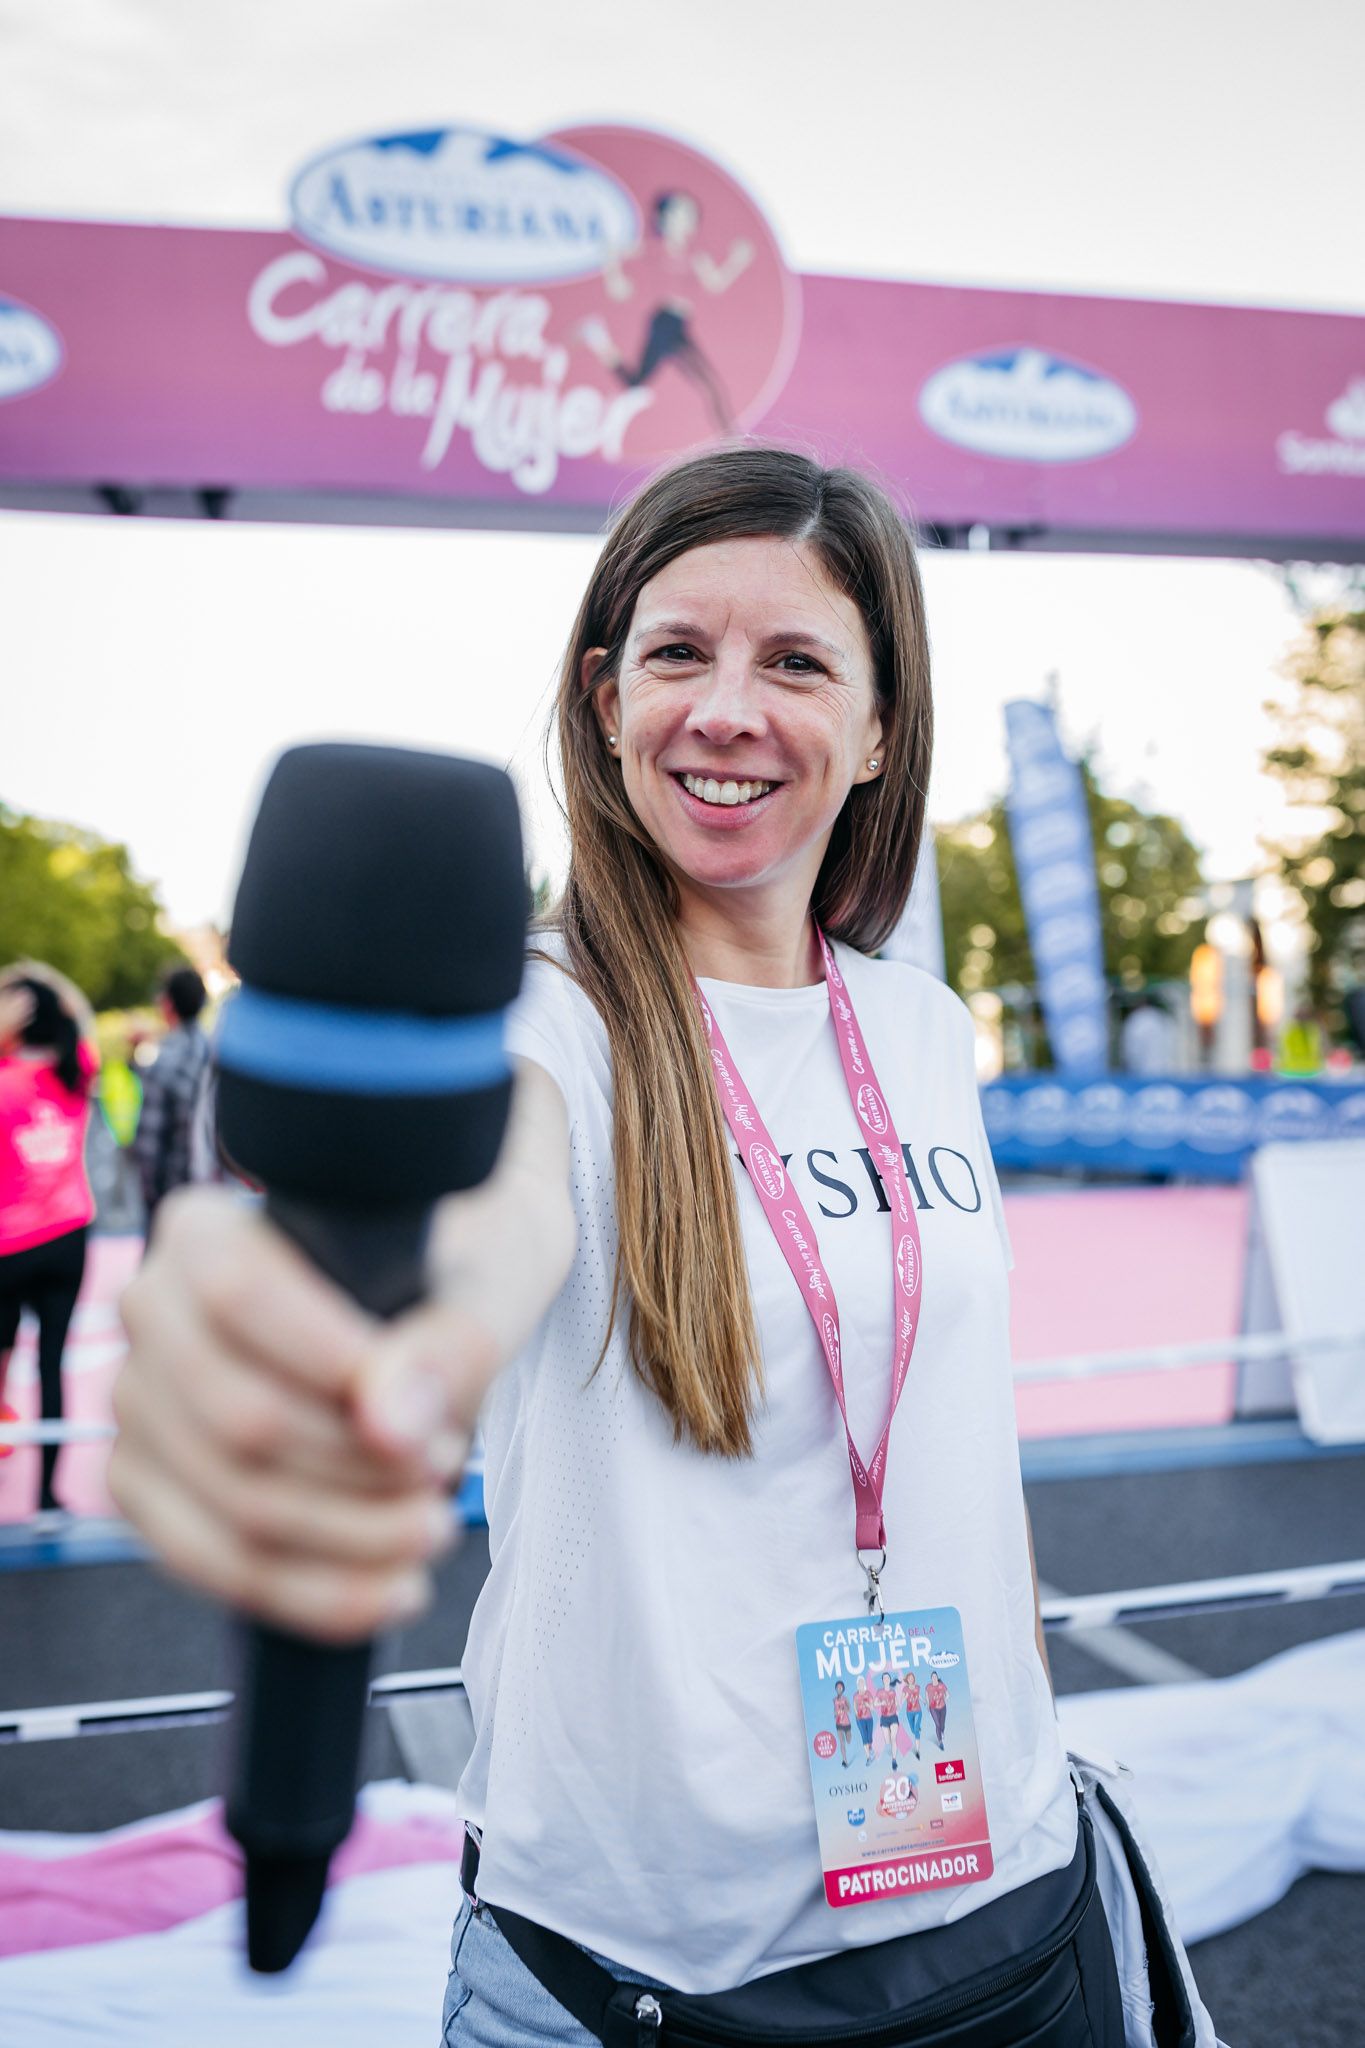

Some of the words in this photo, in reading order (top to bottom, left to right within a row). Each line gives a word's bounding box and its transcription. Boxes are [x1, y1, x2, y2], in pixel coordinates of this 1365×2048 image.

[248, 250, 549, 360] Carrera
[321, 347, 385, 414] de
[390, 343, 437, 416] la
[420, 345, 652, 494] Mujer
[836, 994, 853, 1025] Mujer
[848, 1036, 865, 1075] Carrera
[710, 1049, 734, 1087] Carrera
[732, 1103, 757, 1133] Mujer
[866, 1088, 884, 1131] ASTURIANA
[752, 1147, 778, 1196] ASTURIANA
[877, 1142, 899, 1169] Mujer
[894, 1183, 909, 1223] Carrera
[782, 1209, 808, 1251] Carrera
[806, 1268, 827, 1301] Mujer
[905, 1239, 915, 1292] ASTURIANA
[900, 1306, 912, 1343] Mujer
[823, 1623, 906, 1648] CARRERA
[908, 1627, 921, 1637] DE
[923, 1625, 936, 1636] LA
[816, 1636, 933, 1680] MUJER
[829, 1782, 868, 1797] OYSHO
[884, 1776, 910, 1802] 20
[838, 1854, 980, 1898] PATROCINADOR
